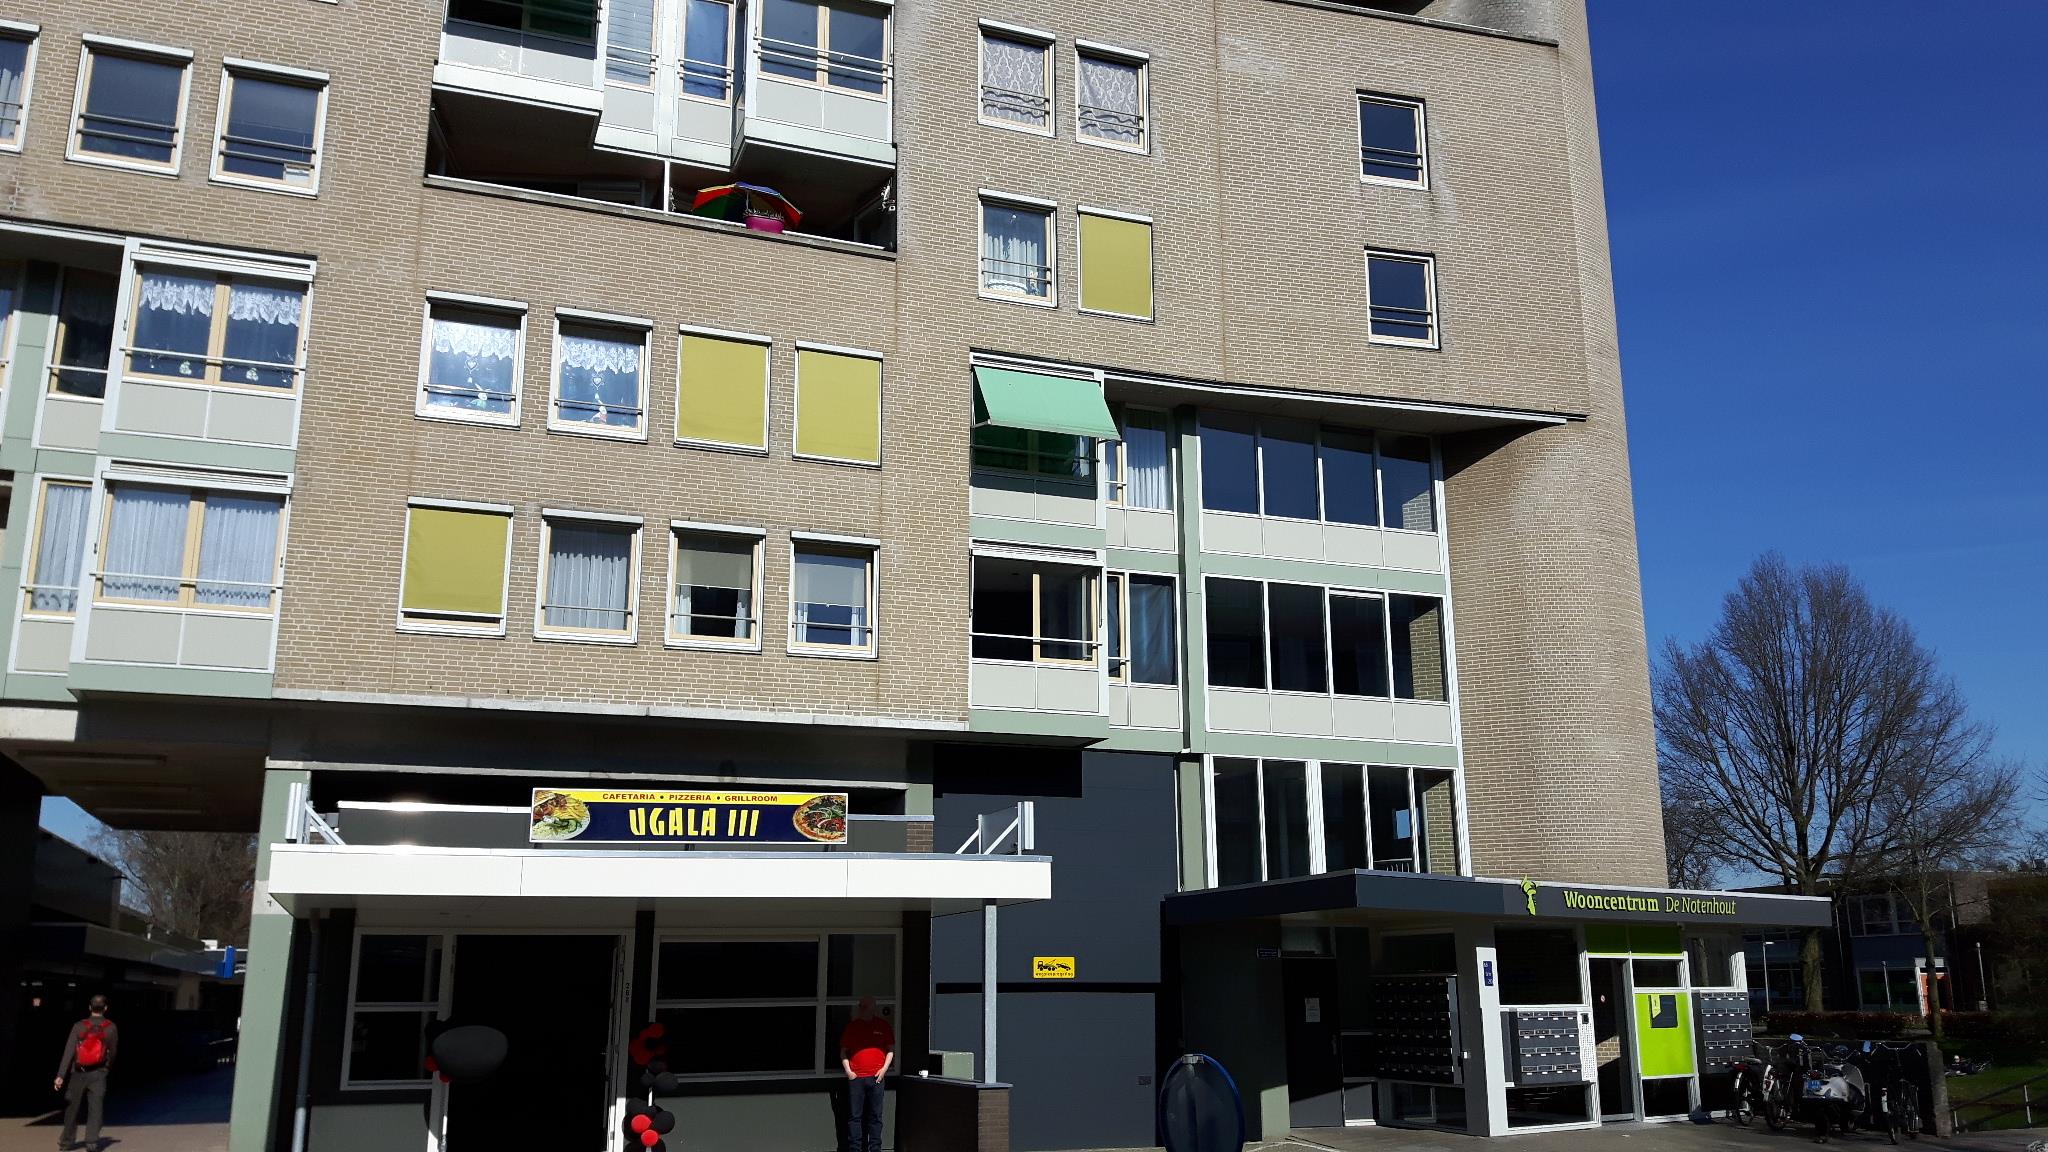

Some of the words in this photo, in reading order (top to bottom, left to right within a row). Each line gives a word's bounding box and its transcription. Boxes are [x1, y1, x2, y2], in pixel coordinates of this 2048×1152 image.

[628, 807, 717, 836] UGALA
[727, 809, 760, 837] III
[1563, 890, 1660, 912] Wooncentrum
[1665, 896, 1680, 913] De
[1681, 896, 1737, 915] Notenhout
